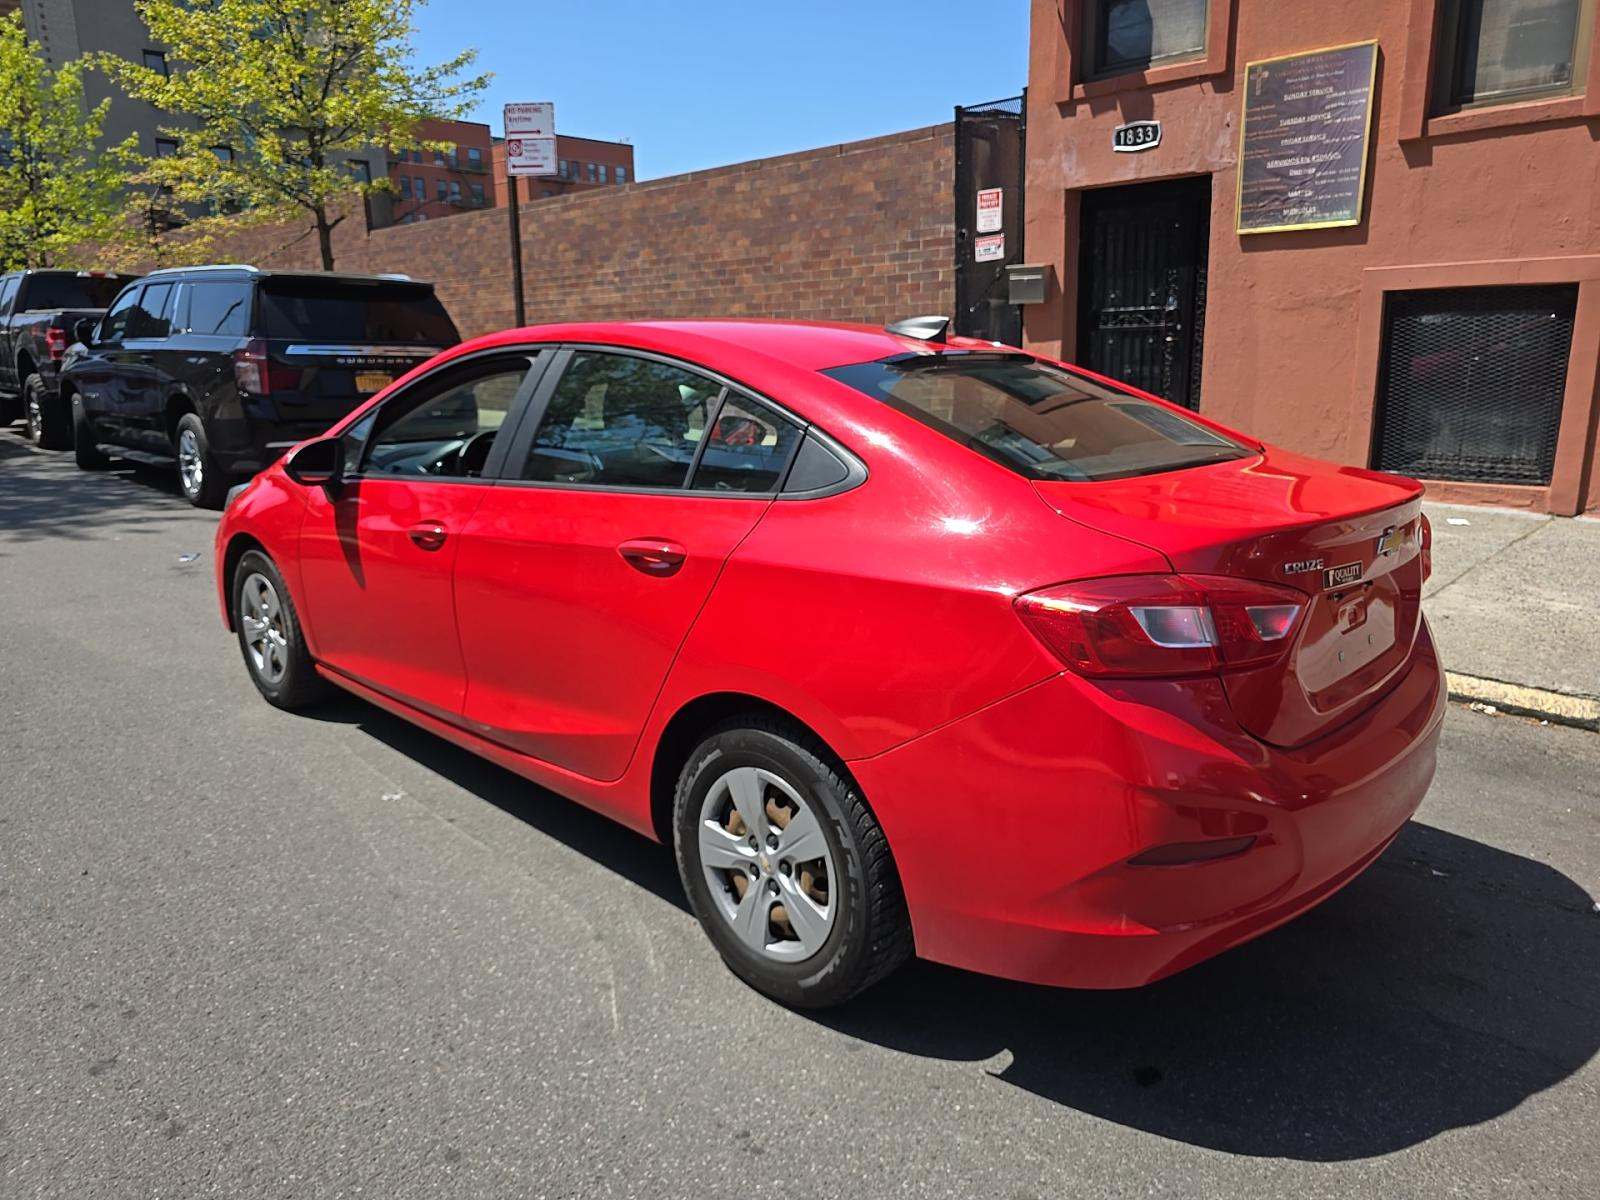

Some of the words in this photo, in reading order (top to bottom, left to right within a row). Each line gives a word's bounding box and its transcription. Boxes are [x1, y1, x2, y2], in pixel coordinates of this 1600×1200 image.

[1283, 90, 1308, 102] SUNDAY
[1119, 126, 1153, 145] 1833
[1284, 559, 1325, 575] CRUZE
[1334, 565, 1360, 581] QUALITY
